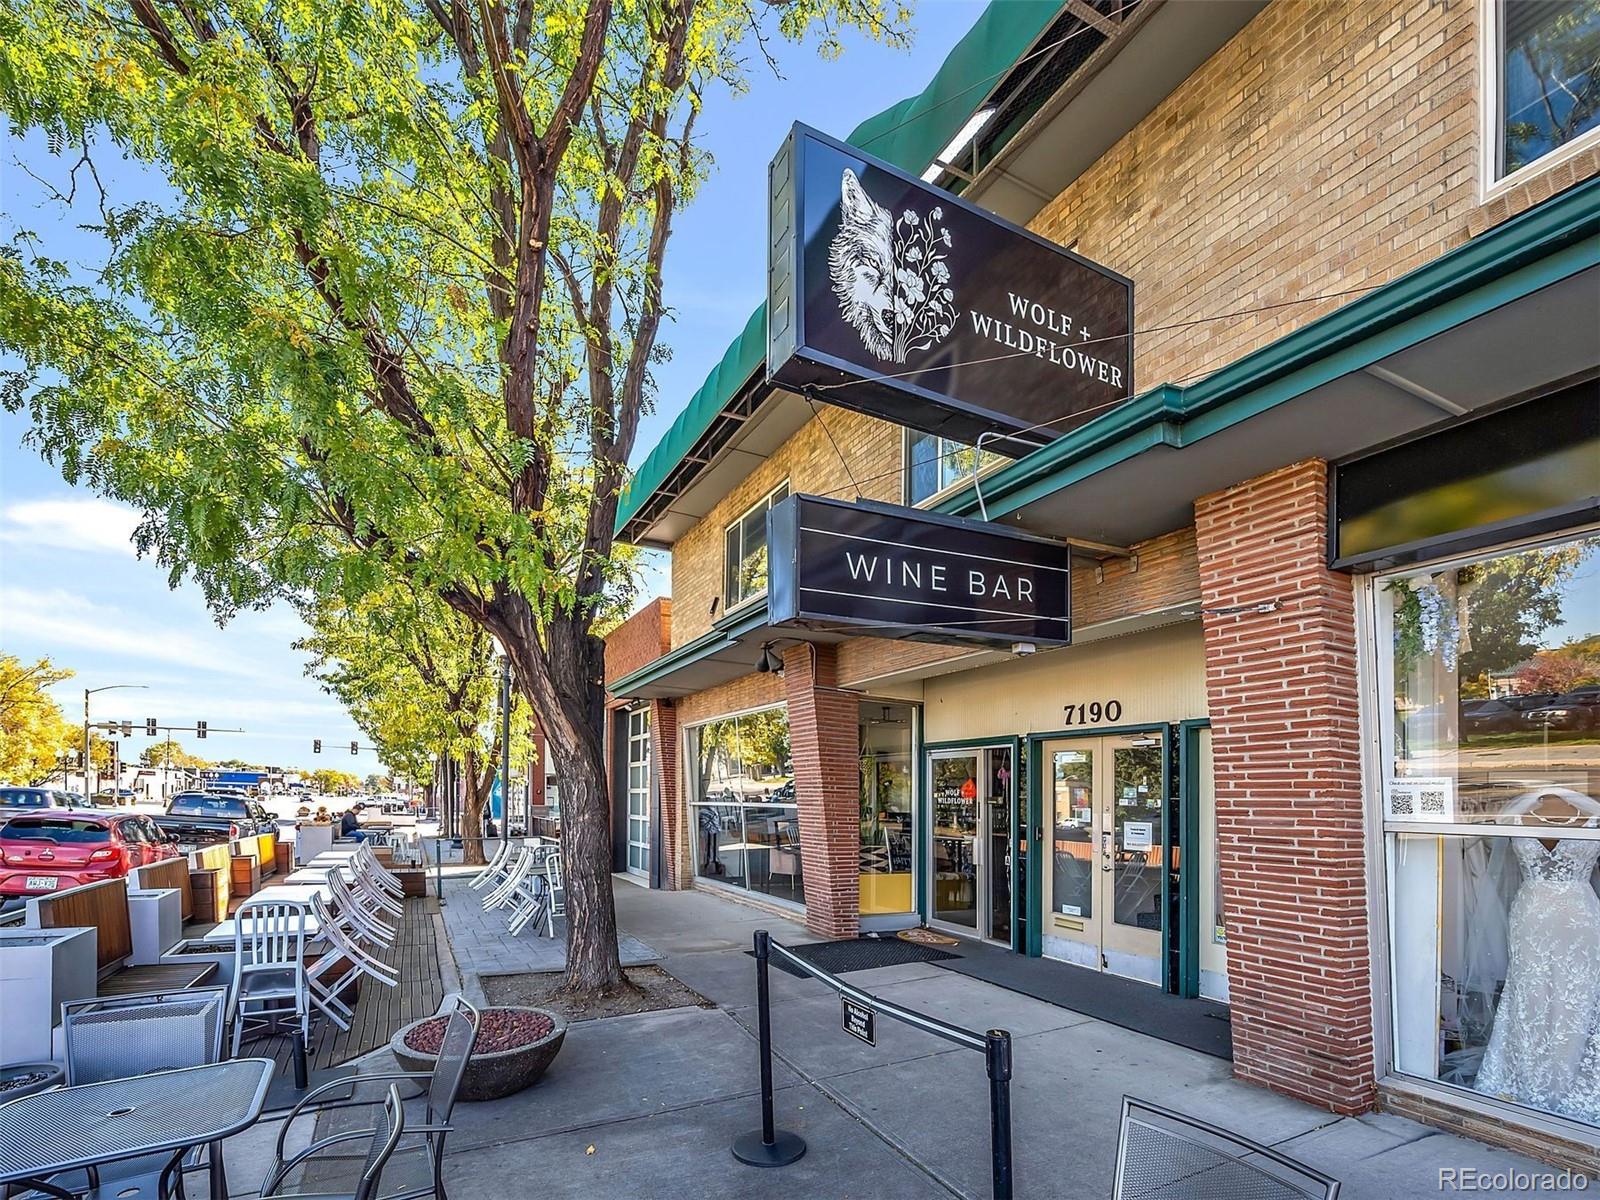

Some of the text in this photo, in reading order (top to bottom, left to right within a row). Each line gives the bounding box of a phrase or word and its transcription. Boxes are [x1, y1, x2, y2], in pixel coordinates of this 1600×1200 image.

[1008, 292, 1072, 336] WOLF
[970, 310, 1123, 388] WILDFLOWER
[846, 552, 1034, 602] WINE BAR
[1063, 700, 1122, 725] 7190
[937, 797, 973, 805] WILDFLOWER
